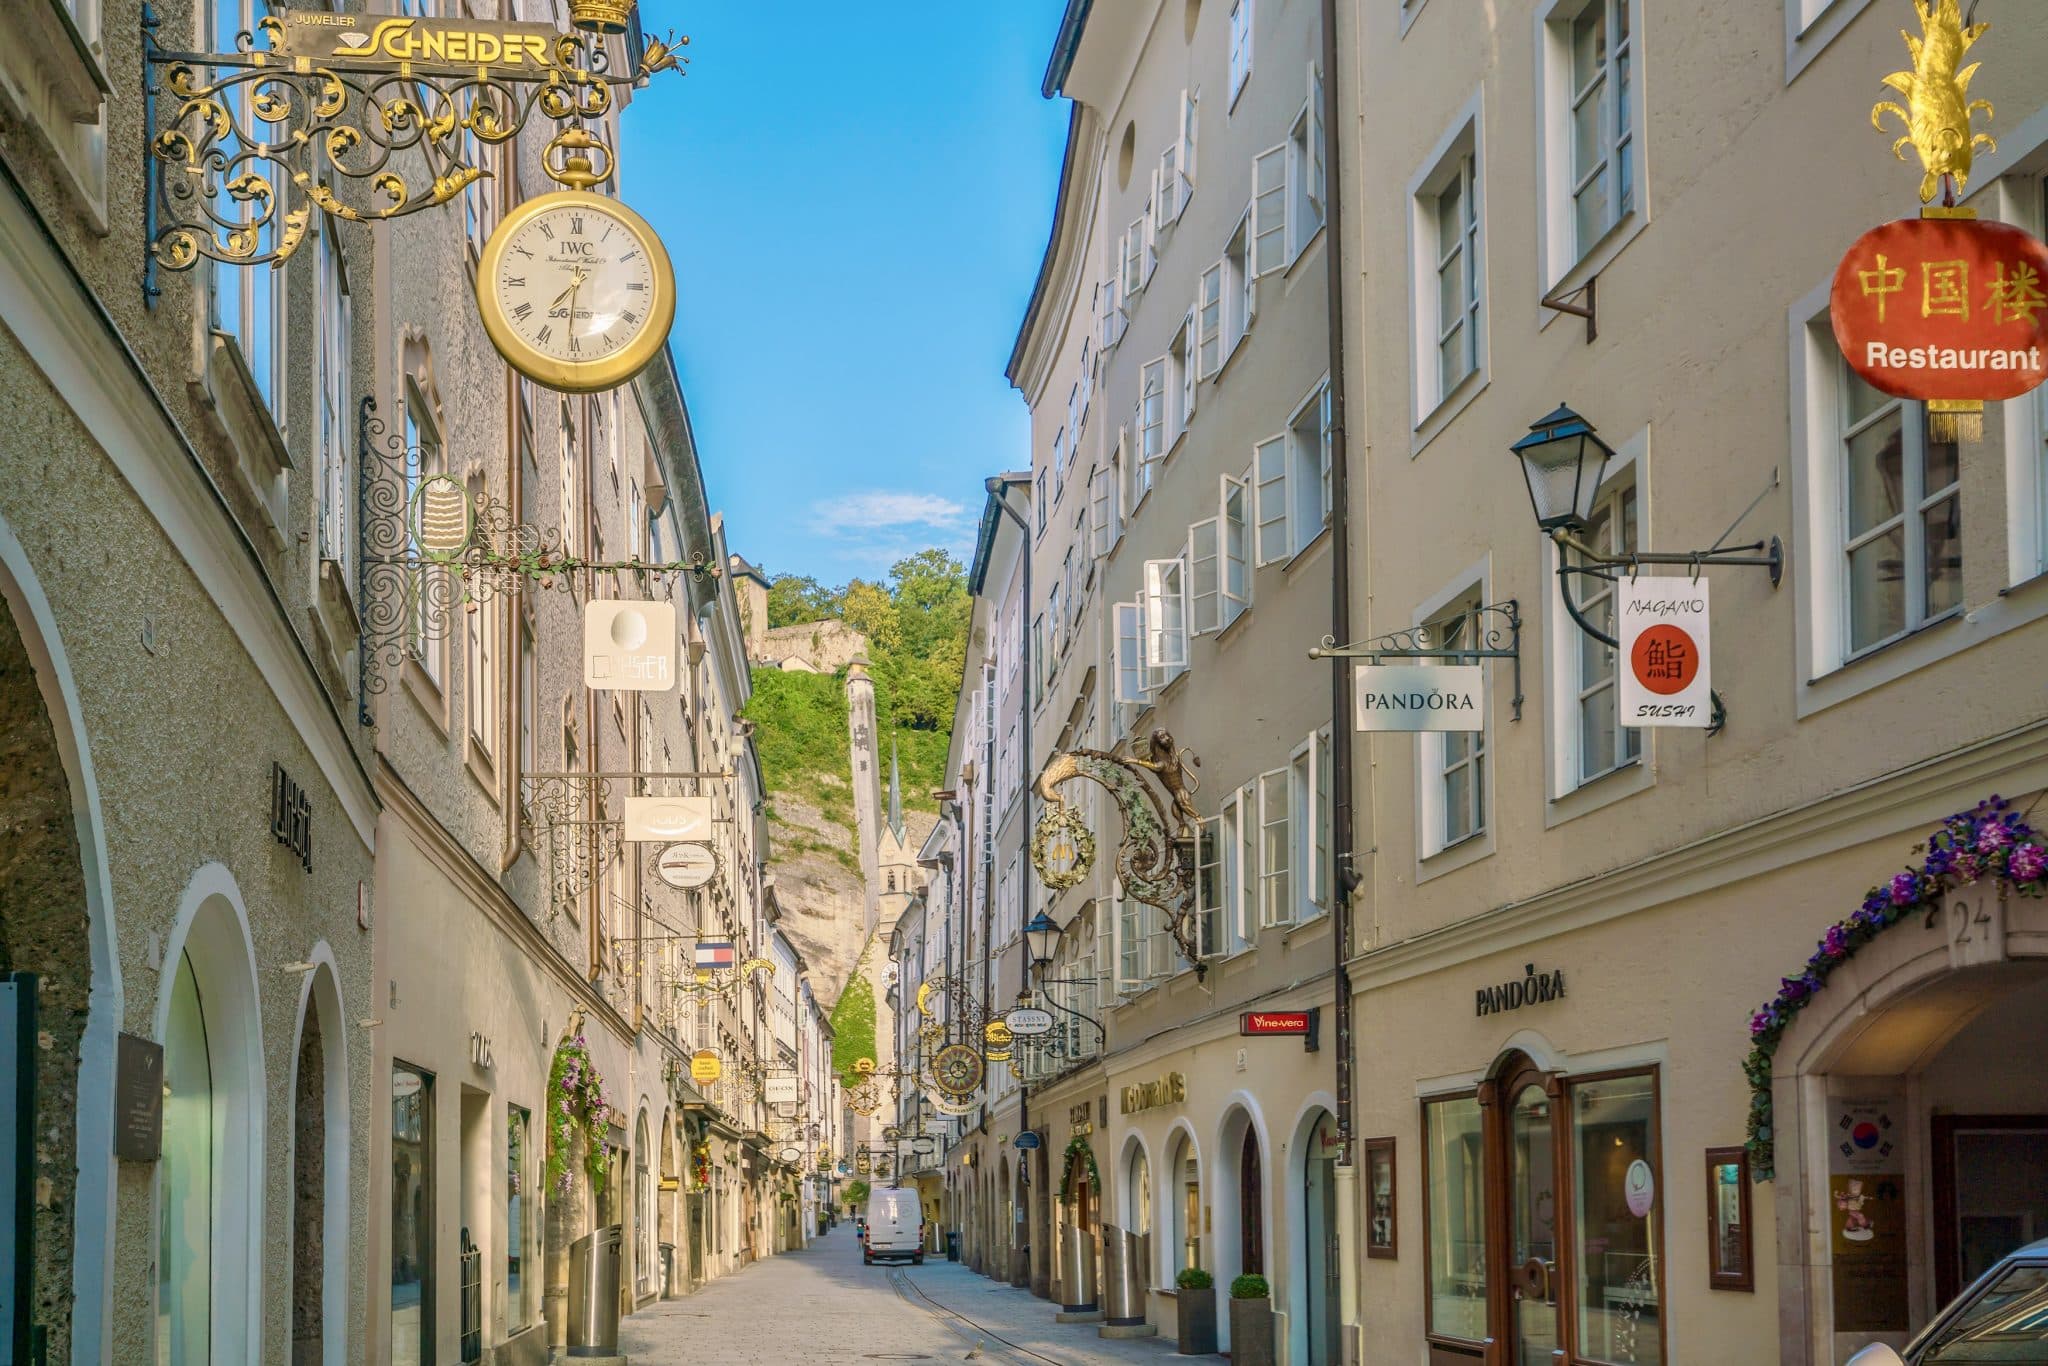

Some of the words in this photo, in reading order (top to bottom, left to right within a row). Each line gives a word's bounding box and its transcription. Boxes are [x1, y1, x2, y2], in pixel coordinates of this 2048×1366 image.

[295, 14, 355, 27] JUWELIER
[332, 19, 551, 66] SCHNEIDER
[560, 241, 594, 256] IWC
[1858, 253, 2048, 327] 中国楼
[1866, 341, 2041, 371] Restaurant
[1626, 599, 1705, 617] NAGANO
[1365, 689, 1475, 710] PANDORA
[1636, 704, 1696, 718] SUSHI
[1953, 895, 1992, 943] 24
[1475, 965, 1565, 1016] PANDORA
